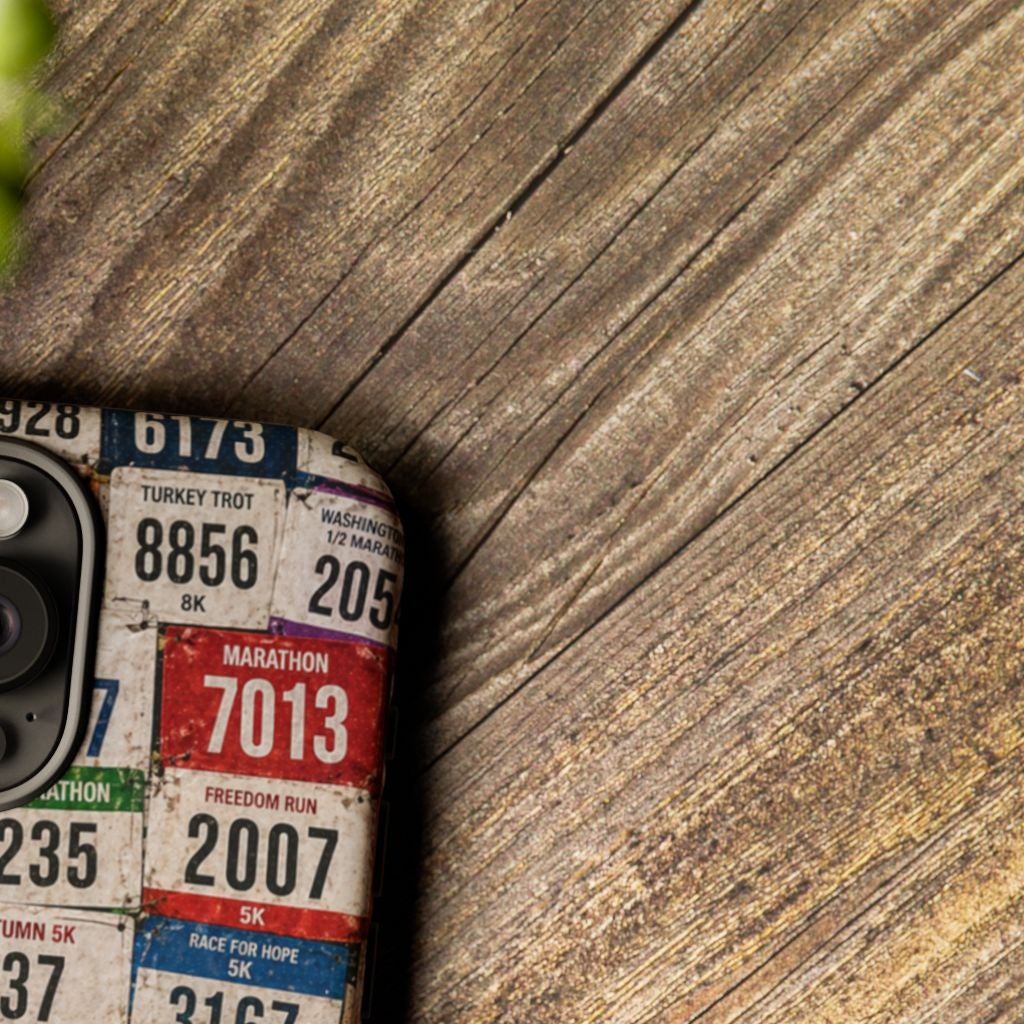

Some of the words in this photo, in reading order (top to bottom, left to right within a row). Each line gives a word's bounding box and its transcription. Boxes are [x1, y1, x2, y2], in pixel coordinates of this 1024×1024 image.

[134, 411, 266, 463] 6173
[141, 485, 207, 506] TURKEY
[212, 491, 254, 510] TROT
[327, 530, 348, 546] 1/2
[135, 518, 259, 590] 8856
[180, 594, 207, 612] 8K
[308, 554, 398, 631] 205
[223, 644, 329, 673] MARATHON
[203, 674, 349, 764] 7013
[205, 786, 280, 811] FREEDOM
[284, 794, 318, 815] RUN
[184, 813, 339, 901] 2007
[239, 905, 266, 926] 5K
[51, 924, 76, 944] 5K
[188, 932, 227, 954] RACE
[229, 939, 258, 957] FOR
[261, 944, 299, 964] HOPE
[227, 958, 253, 979] 5K
